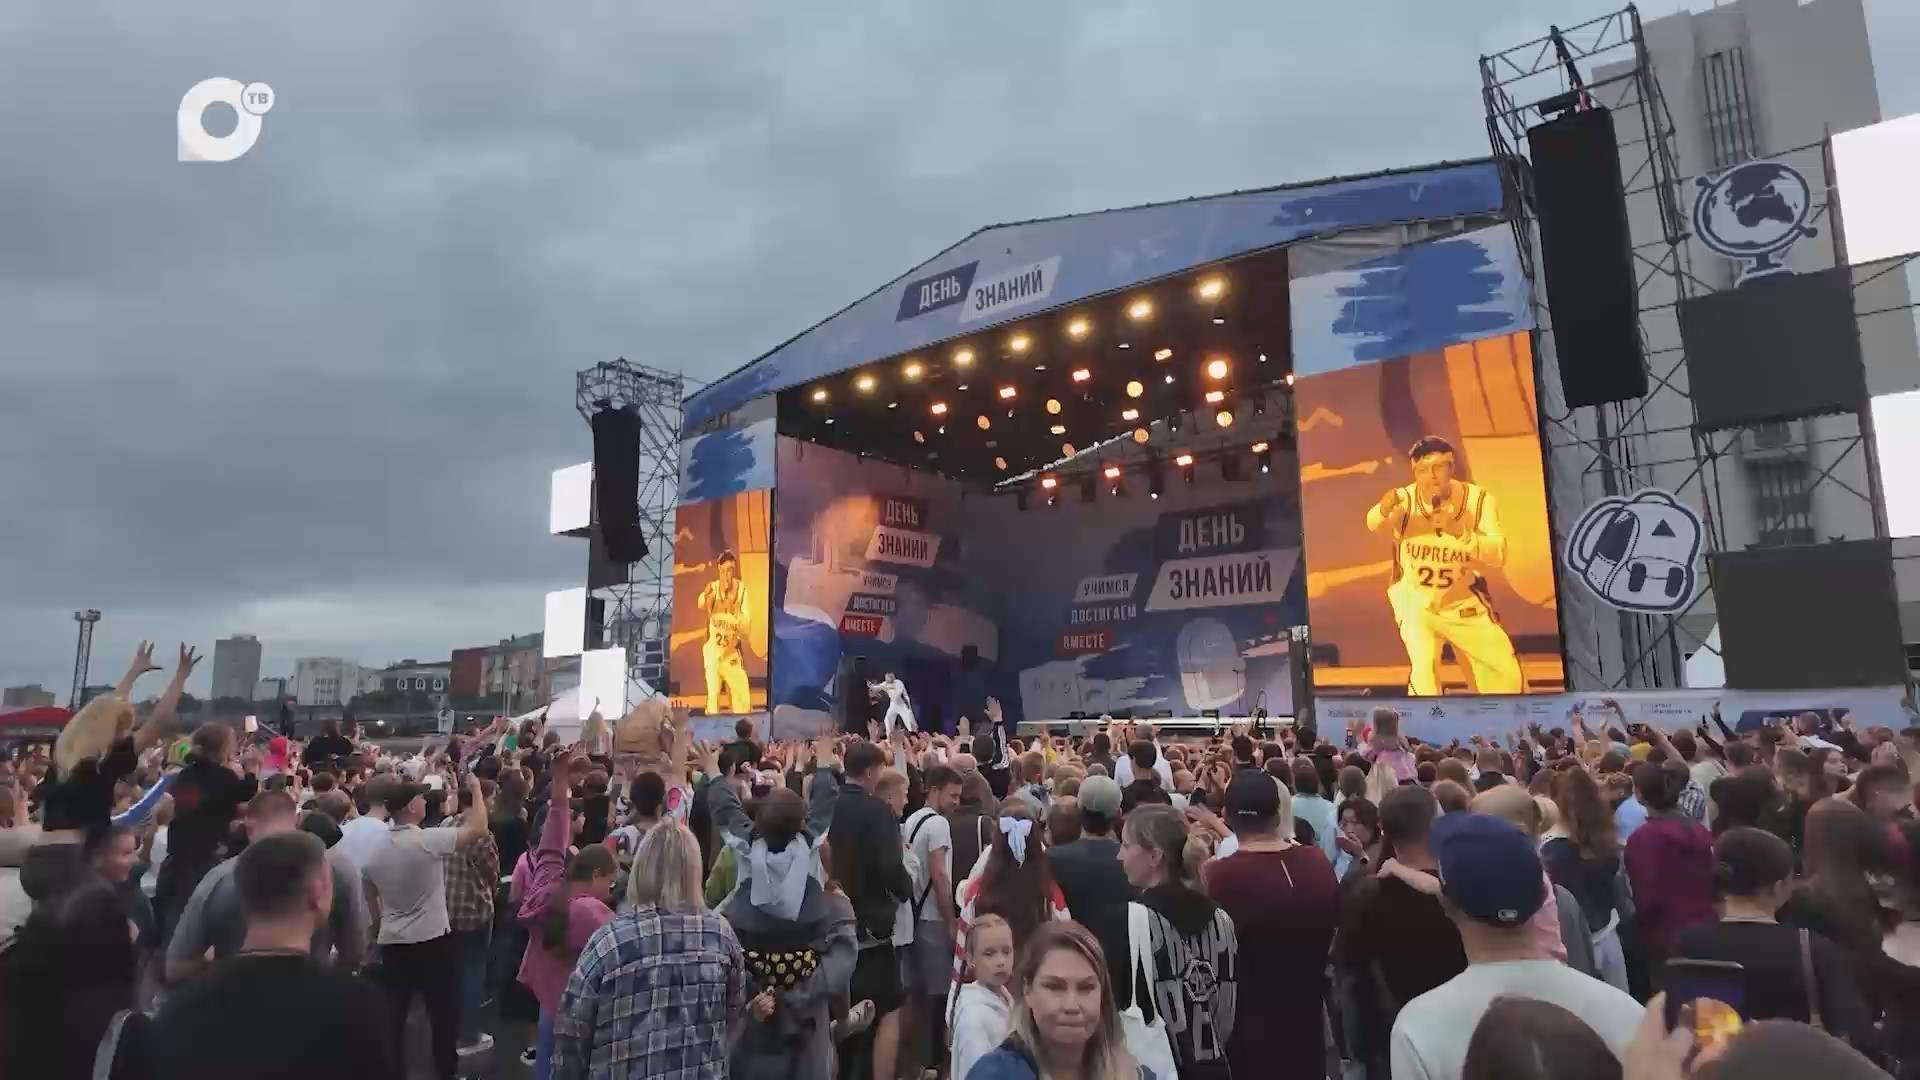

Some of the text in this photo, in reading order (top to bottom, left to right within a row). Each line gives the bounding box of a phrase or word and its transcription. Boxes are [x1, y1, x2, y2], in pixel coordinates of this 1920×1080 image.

[919, 265, 1043, 312] ДЕНЬ ЗНАНИЙ
[885, 500, 919, 525] ДЕНЬ
[1178, 512, 1245, 552] ДЕНЬ
[878, 533, 928, 560] ЗНАНИЙ
[1083, 579, 1129, 596] УЧИМСЯ
[1168, 555, 1272, 600] ЗНАНИЙ
[1418, 567, 1453, 588] 25
[1071, 603, 1137, 625] ДОСТИГАЕМ
[1063, 633, 1105, 649] ВМЕСТЕ
